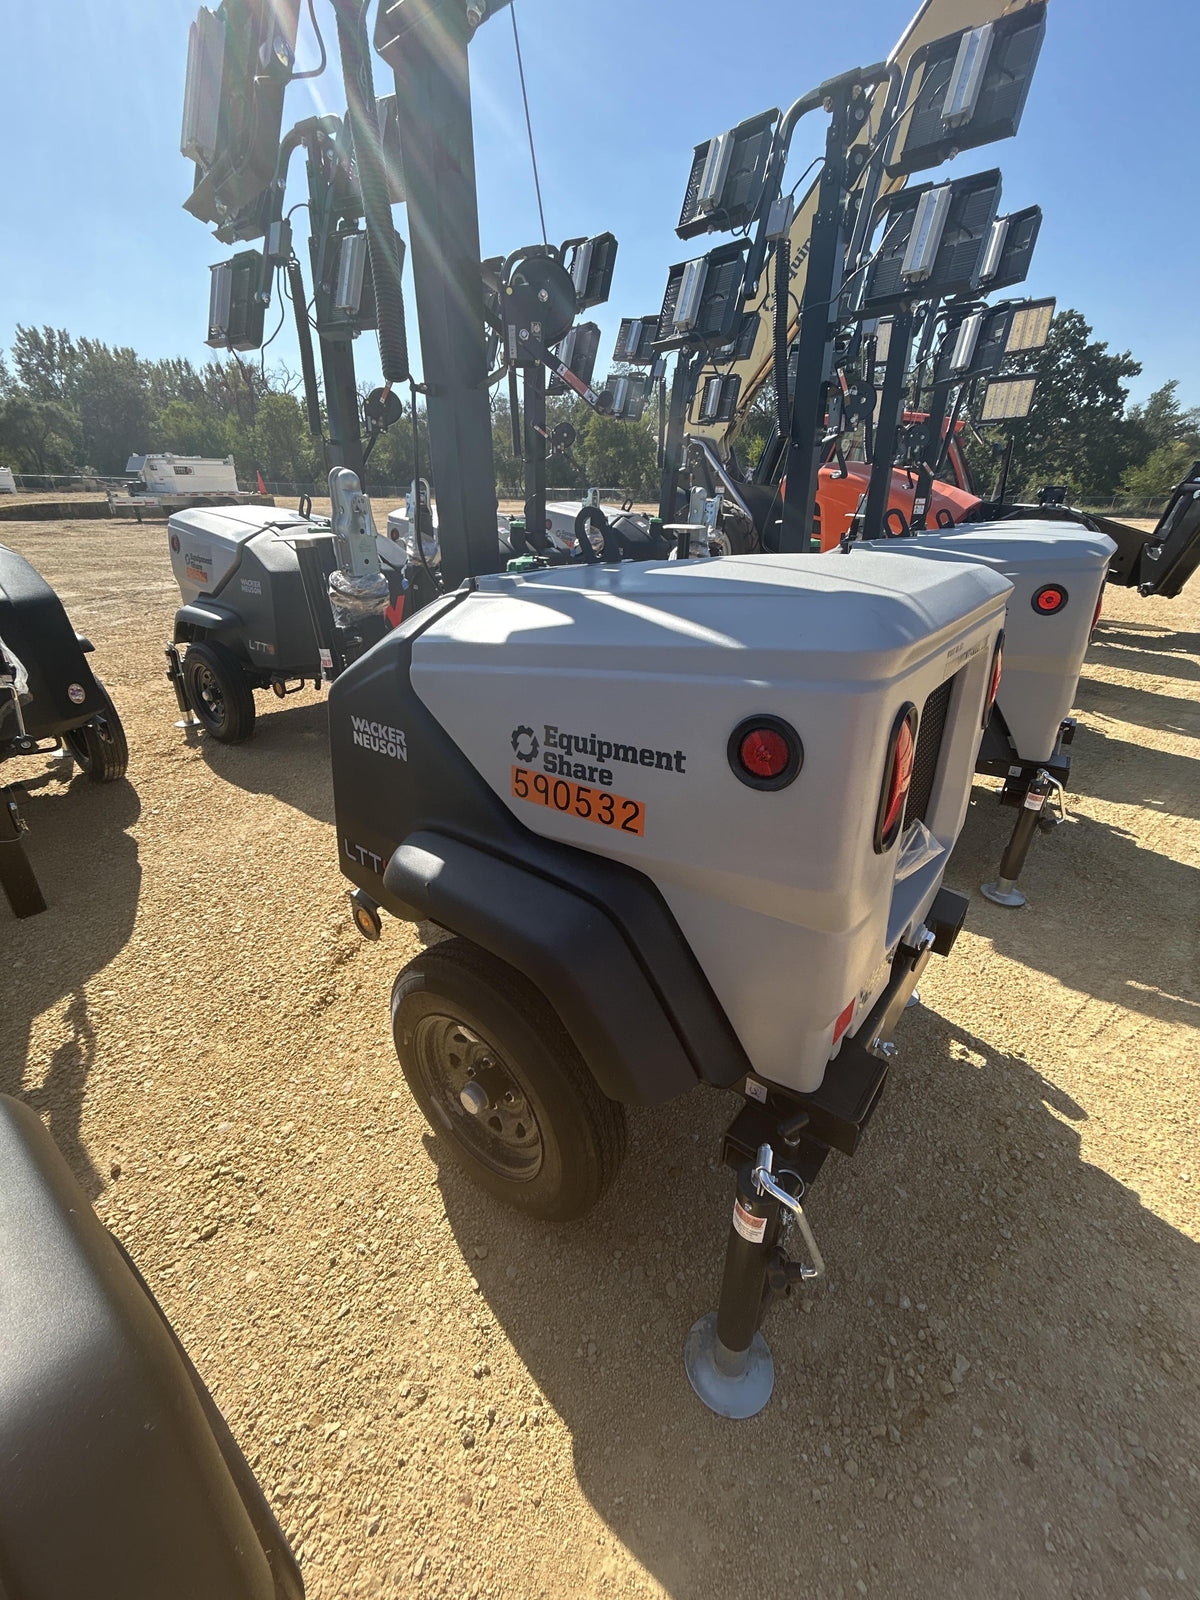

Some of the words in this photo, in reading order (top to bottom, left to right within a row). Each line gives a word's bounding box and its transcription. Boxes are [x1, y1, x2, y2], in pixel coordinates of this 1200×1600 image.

[350, 714, 407, 747] WACKER
[352, 730, 408, 762] NEUSON
[543, 724, 687, 774] Equipment
[543, 751, 613, 787] Share
[514, 767, 640, 834] 590532
[344, 838, 387, 873] LTT
